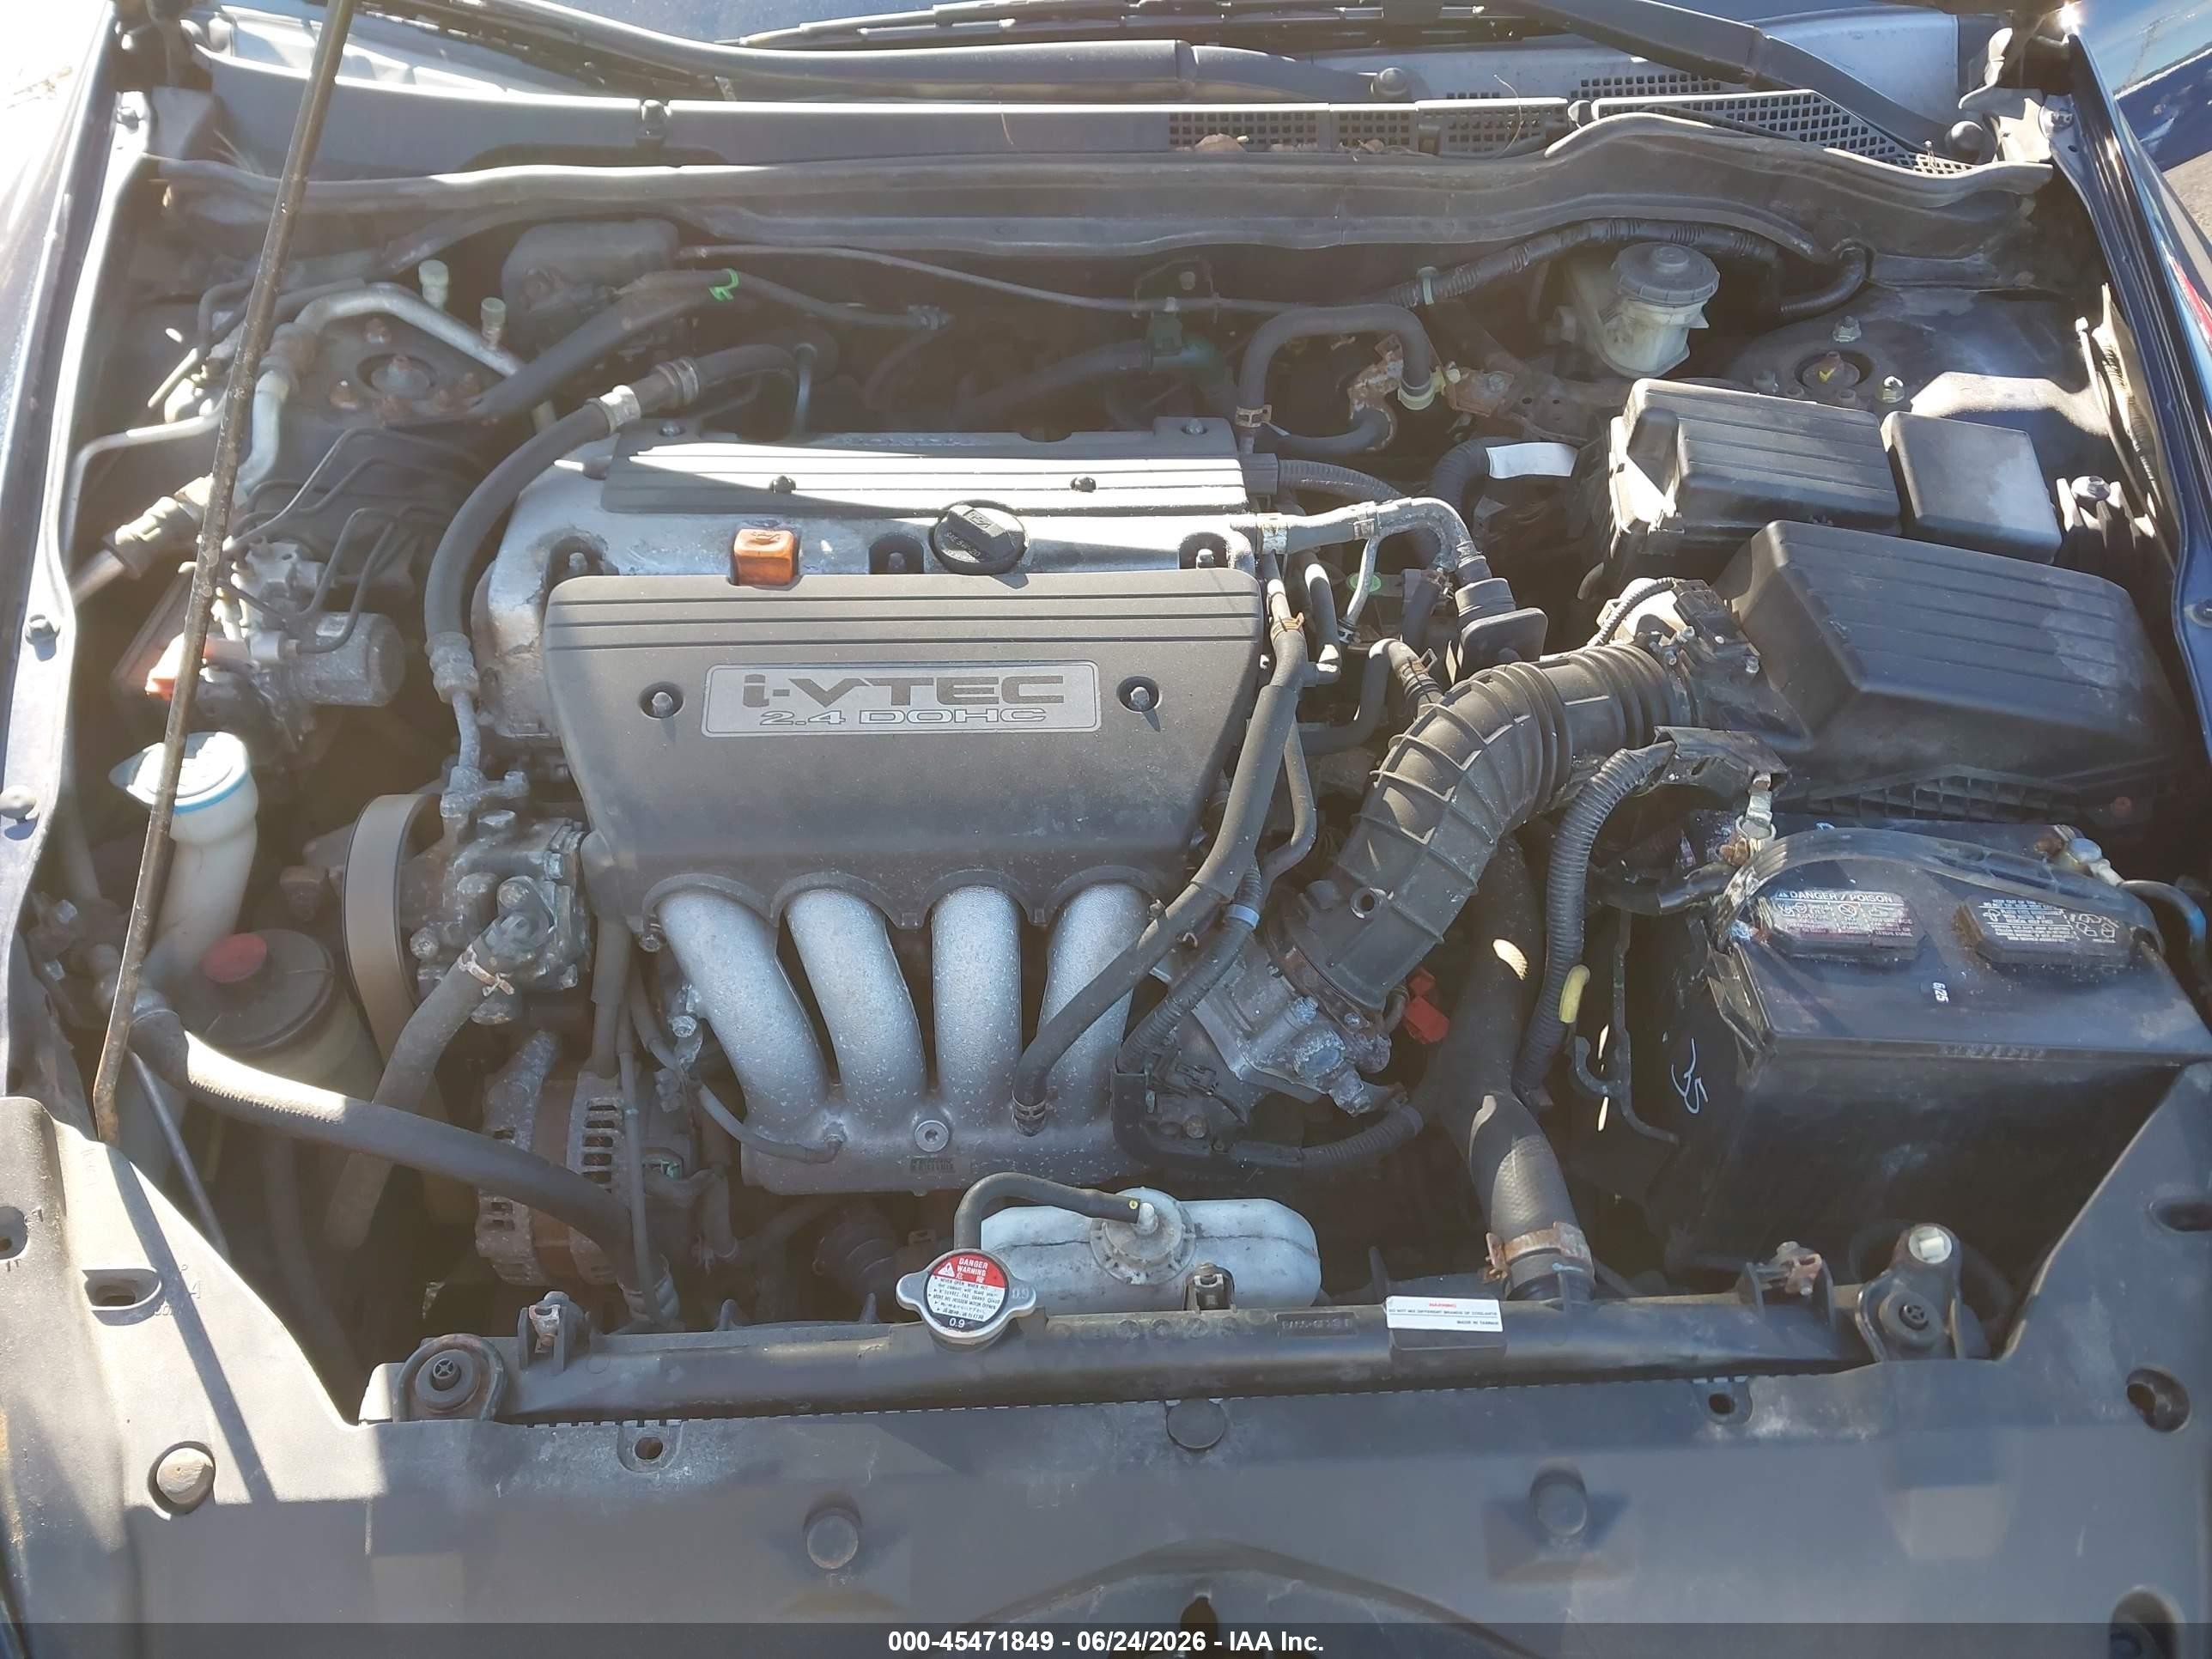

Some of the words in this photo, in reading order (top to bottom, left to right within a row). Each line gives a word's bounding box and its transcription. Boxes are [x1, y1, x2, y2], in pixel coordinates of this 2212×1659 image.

[743, 673, 1065, 708] i-VTEC
[759, 709, 846, 726] 2.4
[859, 708, 1047, 726] DOHC
[1790, 891, 1837, 901] DANGER
[1850, 894, 1893, 903] POISON
[1933, 981, 1949, 1004] 6/25
[959, 1257, 988, 1270] DANGER
[957, 1265, 987, 1277] WARNING
[1011, 1288, 1029, 1299] 0.9
[949, 1317, 965, 1328] 0.9
